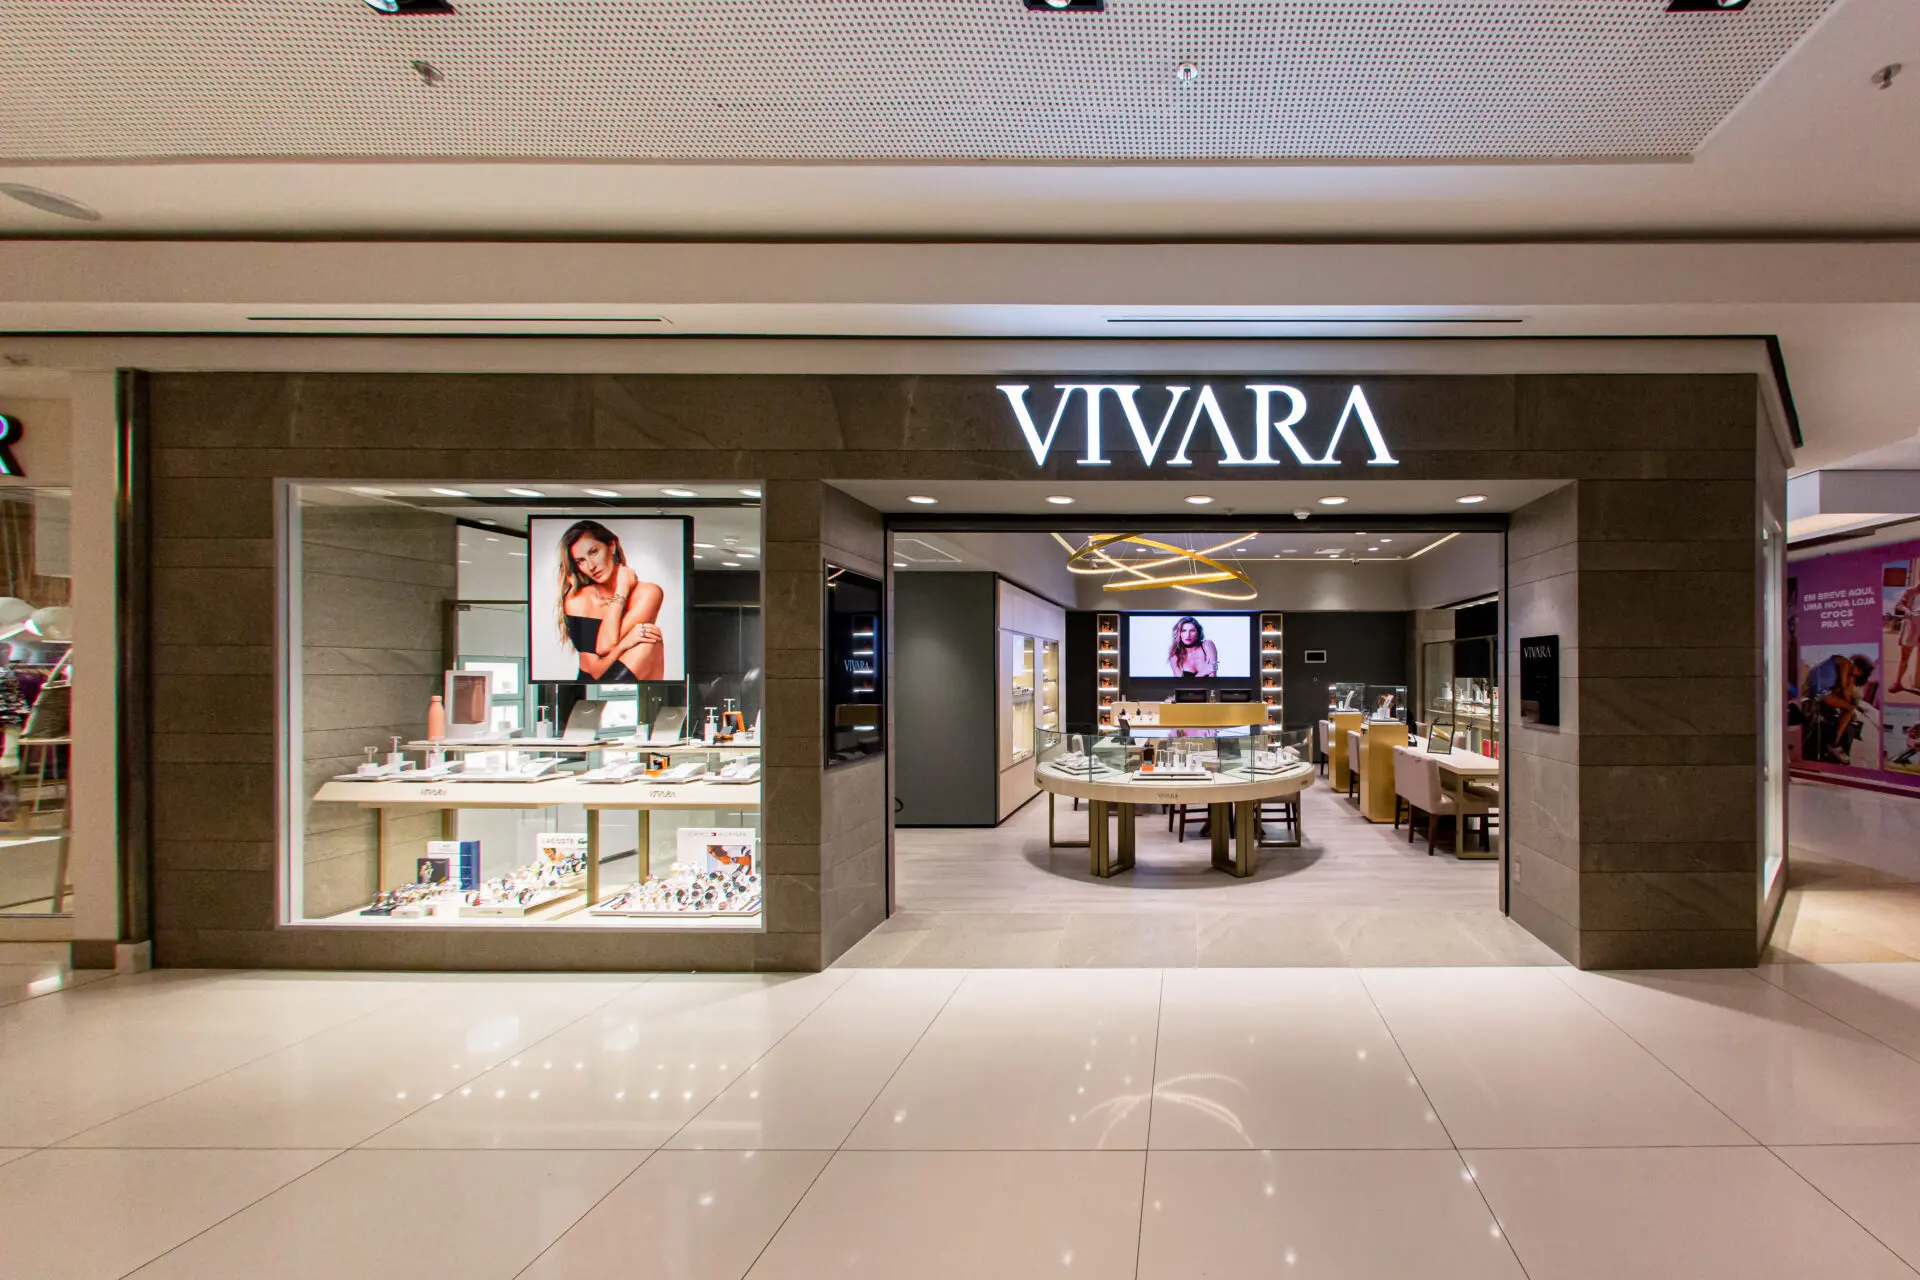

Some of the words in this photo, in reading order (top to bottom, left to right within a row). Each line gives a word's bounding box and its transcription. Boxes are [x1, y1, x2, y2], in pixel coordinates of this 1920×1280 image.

[996, 384, 1400, 468] VIVARA
[1803, 593, 1817, 602] EM
[1818, 590, 1847, 600] BREVE
[1803, 602, 1823, 611] UMA
[1824, 600, 1850, 609] NOVA
[1852, 597, 1876, 607] LOJA
[1820, 609, 1854, 619] crocs
[1821, 620, 1840, 629] PRA
[1841, 619, 1855, 628] VC
[1523, 645, 1552, 659] VIVARA
